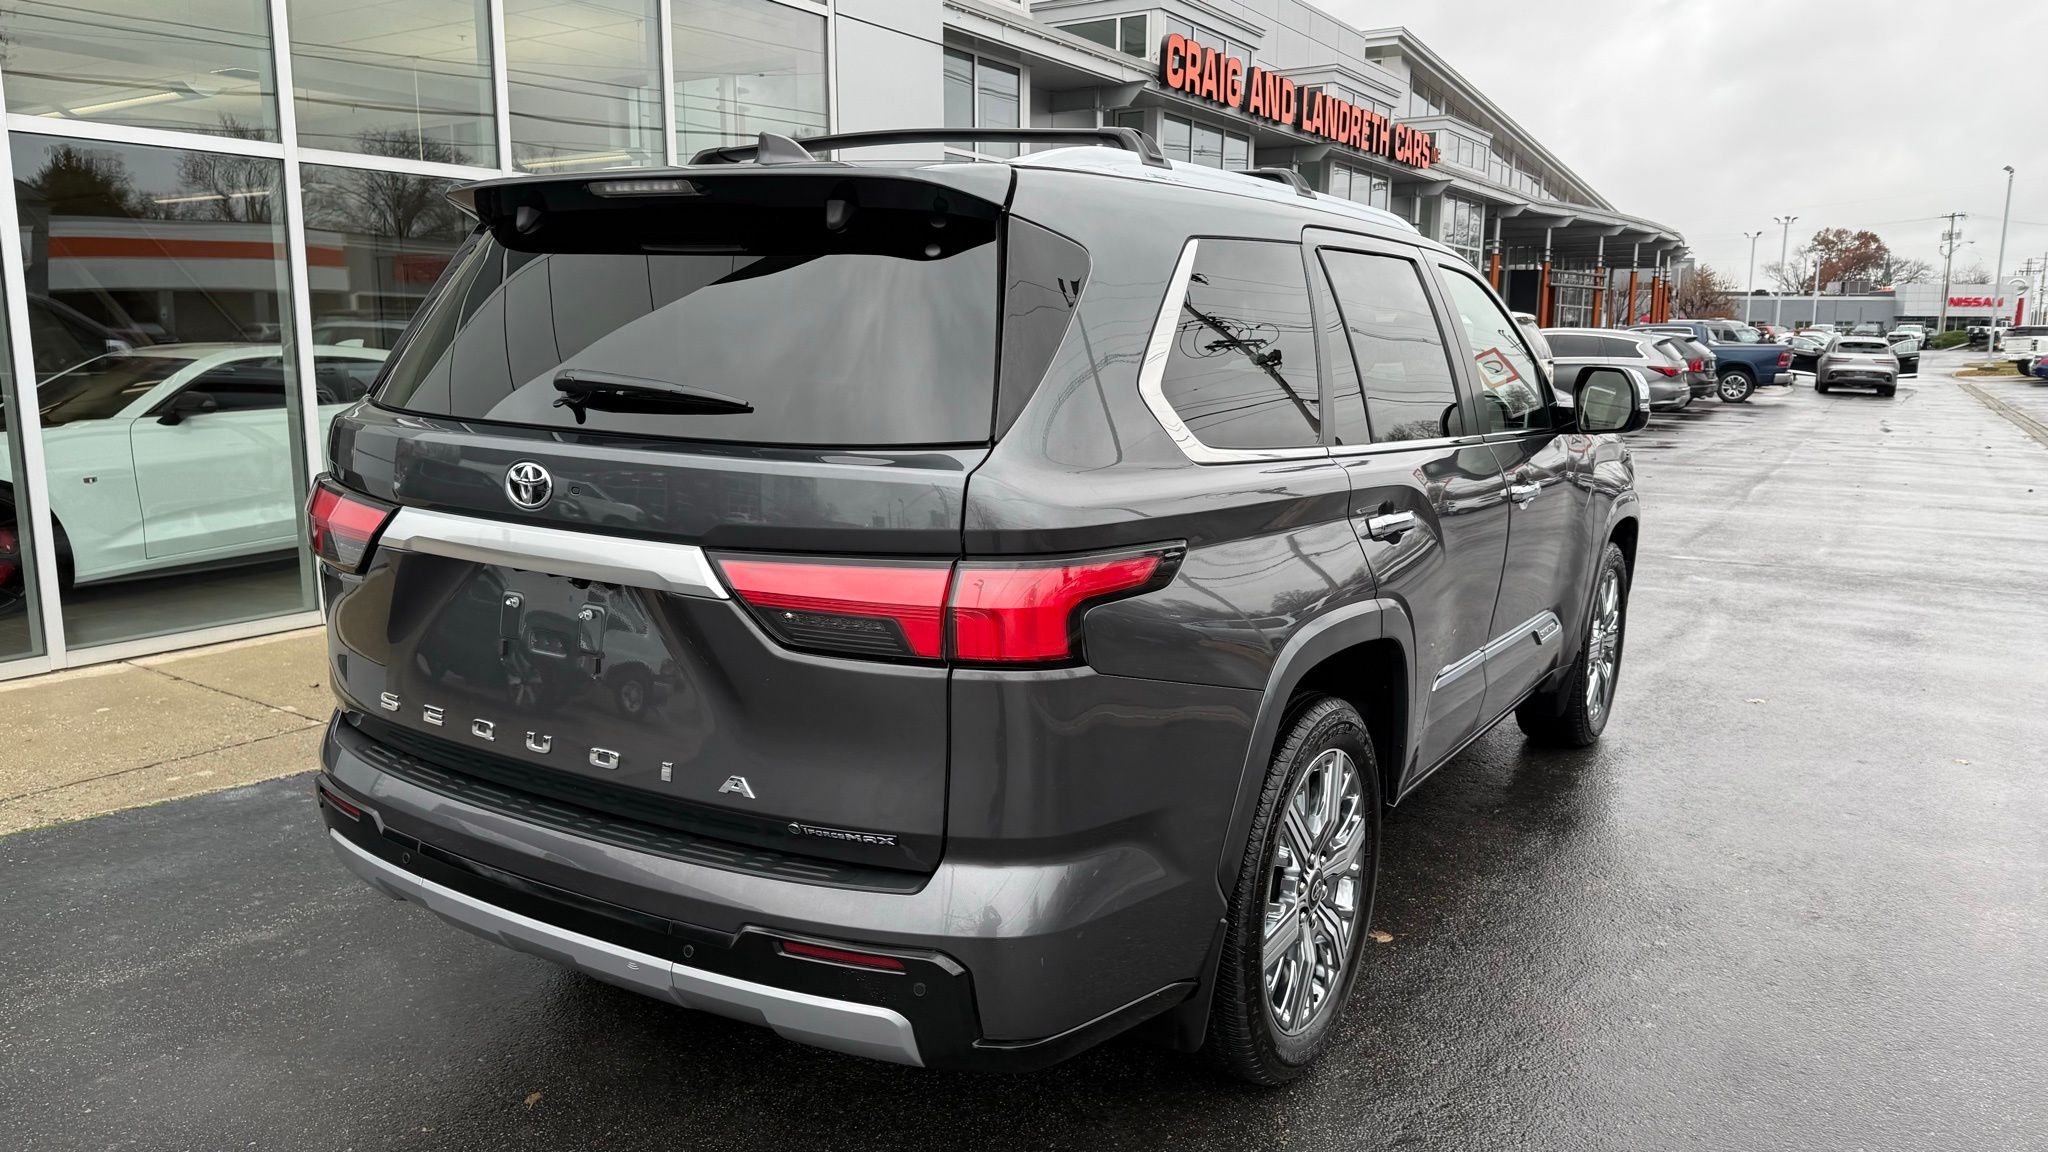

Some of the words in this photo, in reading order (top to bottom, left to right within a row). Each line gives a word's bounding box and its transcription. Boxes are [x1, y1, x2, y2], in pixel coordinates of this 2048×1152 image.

[1165, 33, 1243, 108] CRAIG
[1249, 66, 1296, 125] AND
[1301, 85, 1391, 158] LANDRETH
[1394, 123, 1430, 169] CARS
[380, 691, 756, 800] SEQUOIA
